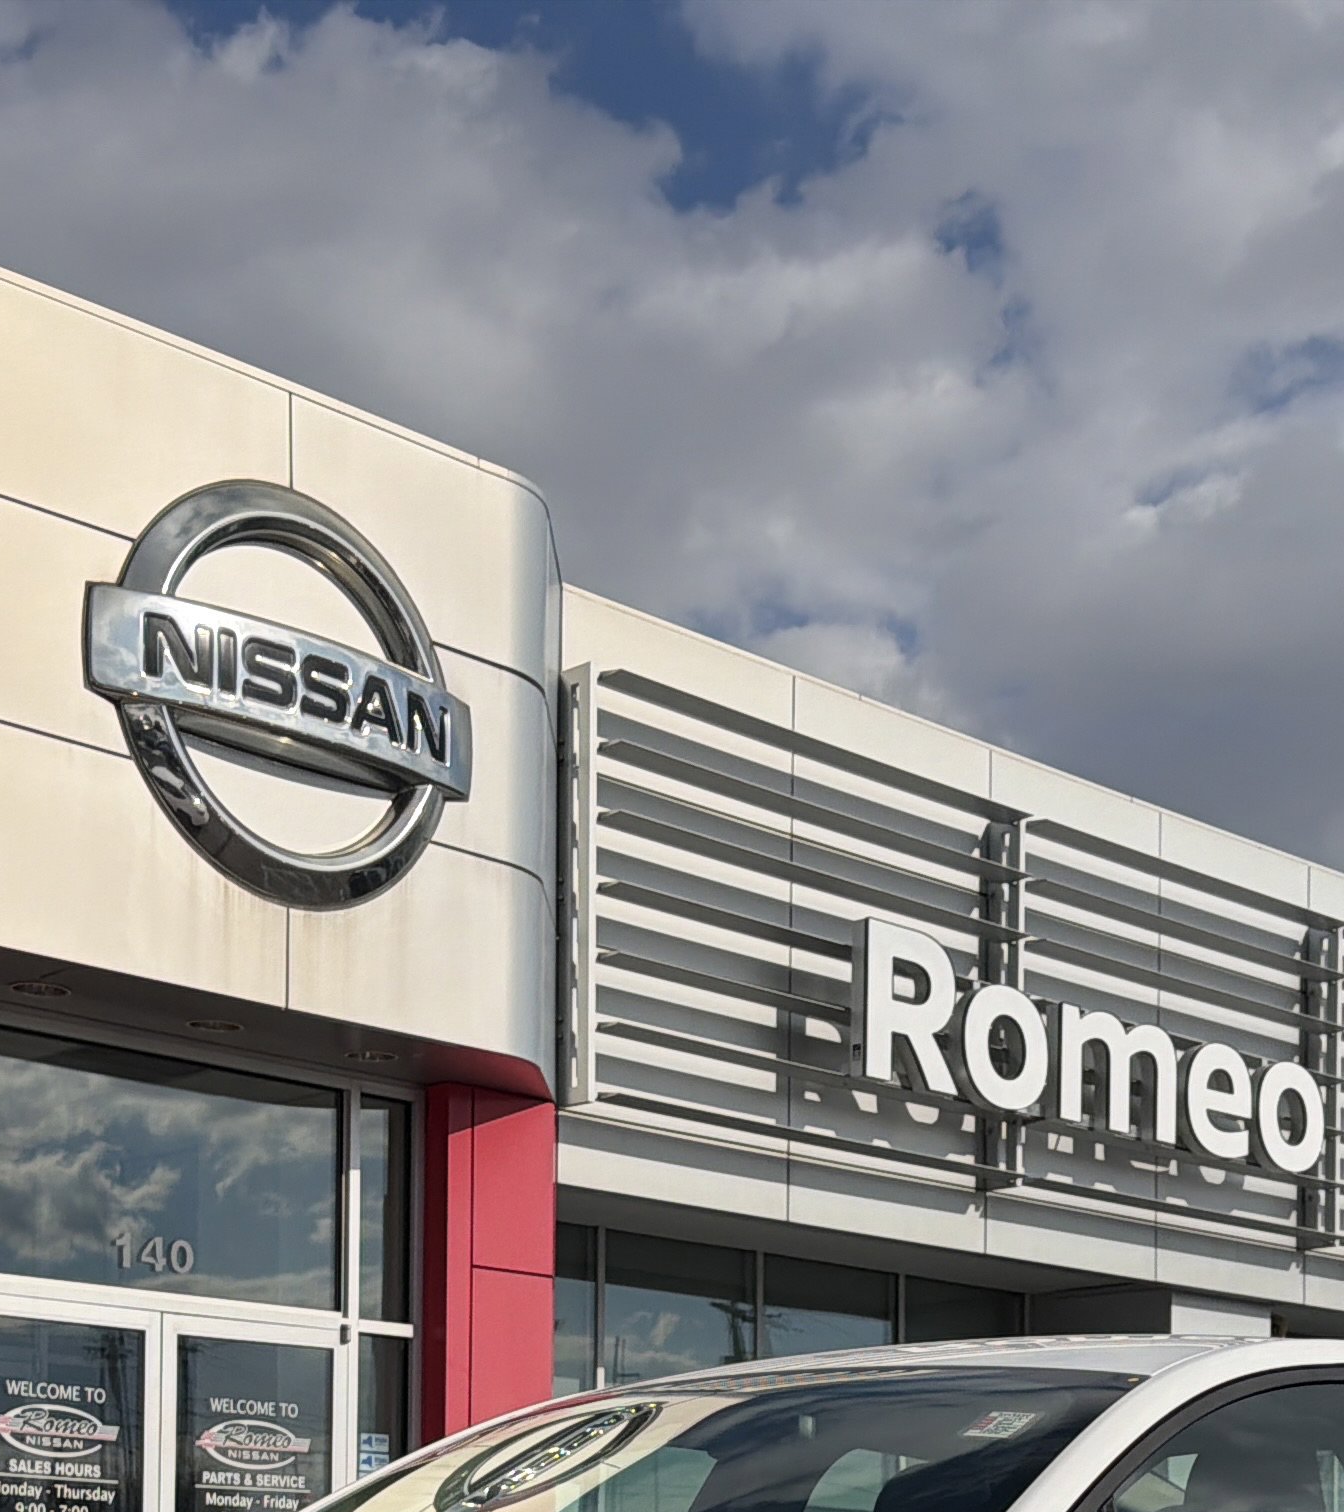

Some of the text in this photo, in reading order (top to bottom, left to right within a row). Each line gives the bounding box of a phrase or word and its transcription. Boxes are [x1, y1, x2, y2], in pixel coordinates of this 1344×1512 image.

[141, 610, 451, 768] NISSAN
[863, 917, 1324, 1173] Romeo
[115, 1231, 194, 1274] 140
[6, 1379, 106, 1404] WELCOME TO
[210, 1397, 299, 1419] WELCOME TO
[18, 1408, 98, 1436] Romeo
[26, 1436, 84, 1449] NISSAN
[222, 1424, 292, 1448] Romeo
[228, 1450, 279, 1461] NISSAN
[8, 1458, 101, 1478] SALES HOURS
[202, 1470, 306, 1489] PARTS & SERVICE
[54, 1484, 115, 1504] Thursday
[205, 1491, 254, 1510] Monday
[263, 1495, 299, 1512] Friday
